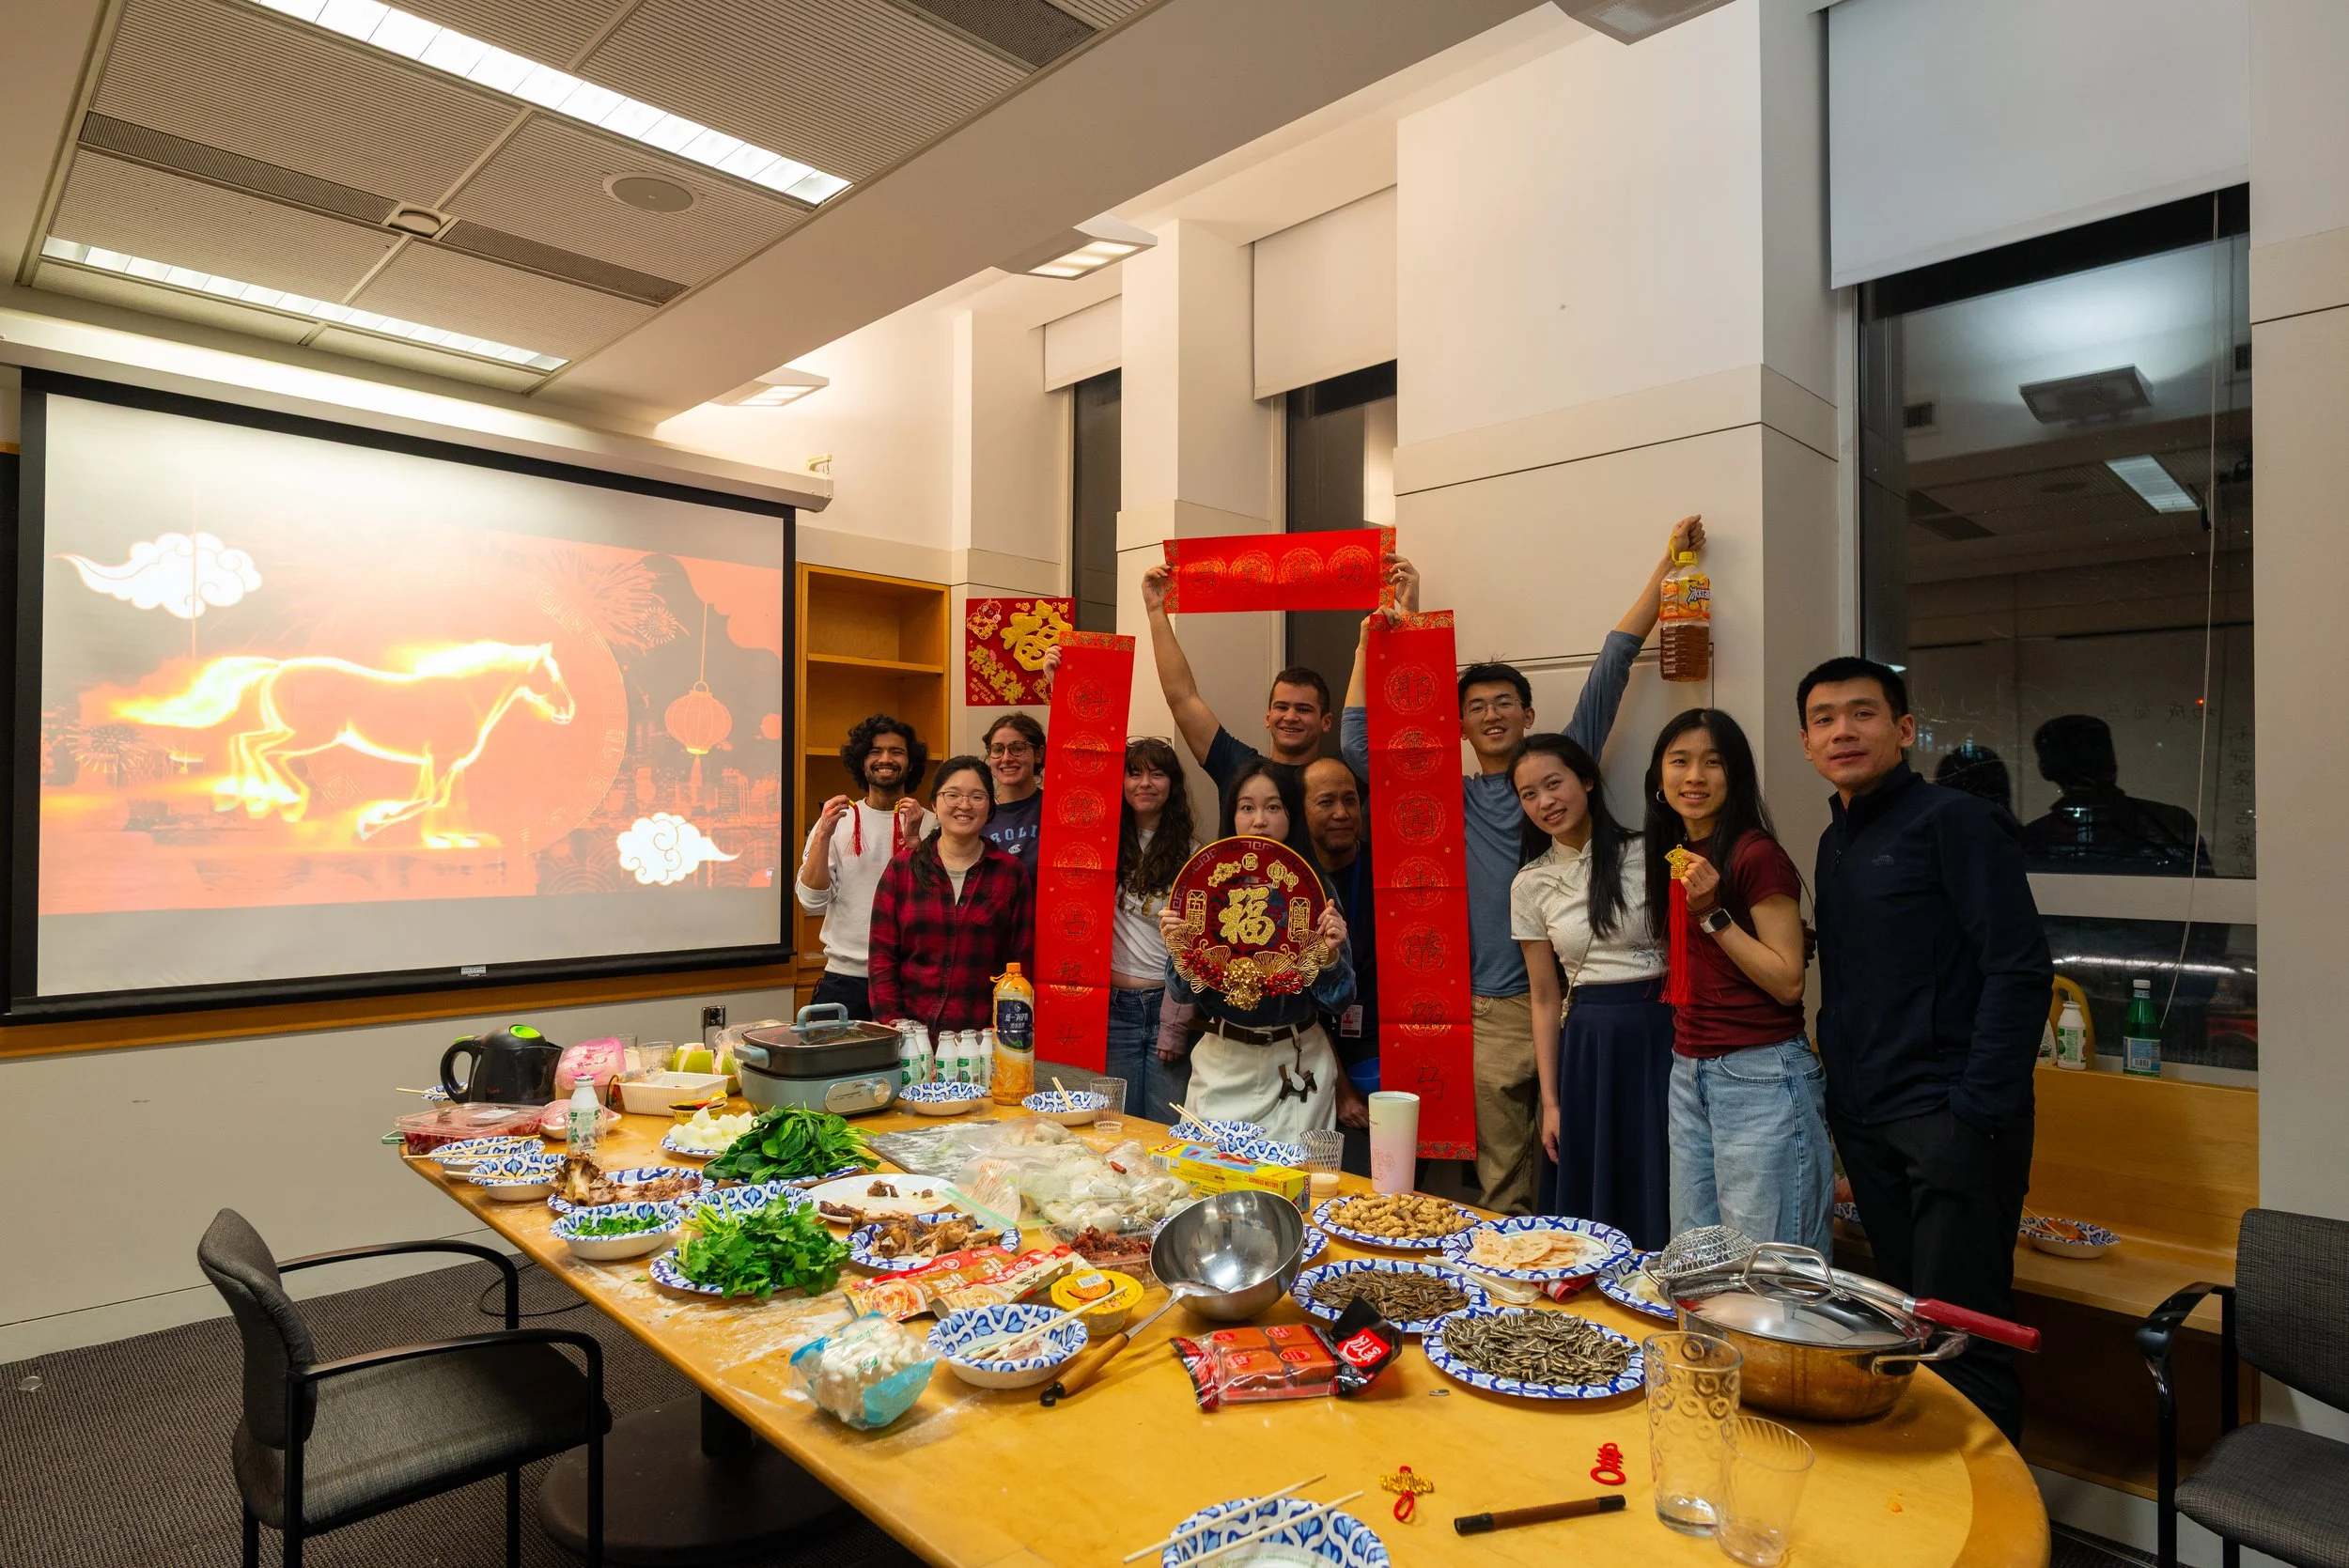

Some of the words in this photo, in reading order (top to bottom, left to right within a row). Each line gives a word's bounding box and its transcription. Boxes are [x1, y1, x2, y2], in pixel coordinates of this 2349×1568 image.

[1000, 599, 1073, 672] 福
[976, 680, 991, 695] HAPPY
[979, 691, 992, 704] YEAR
[1218, 886, 1276, 946] 福
